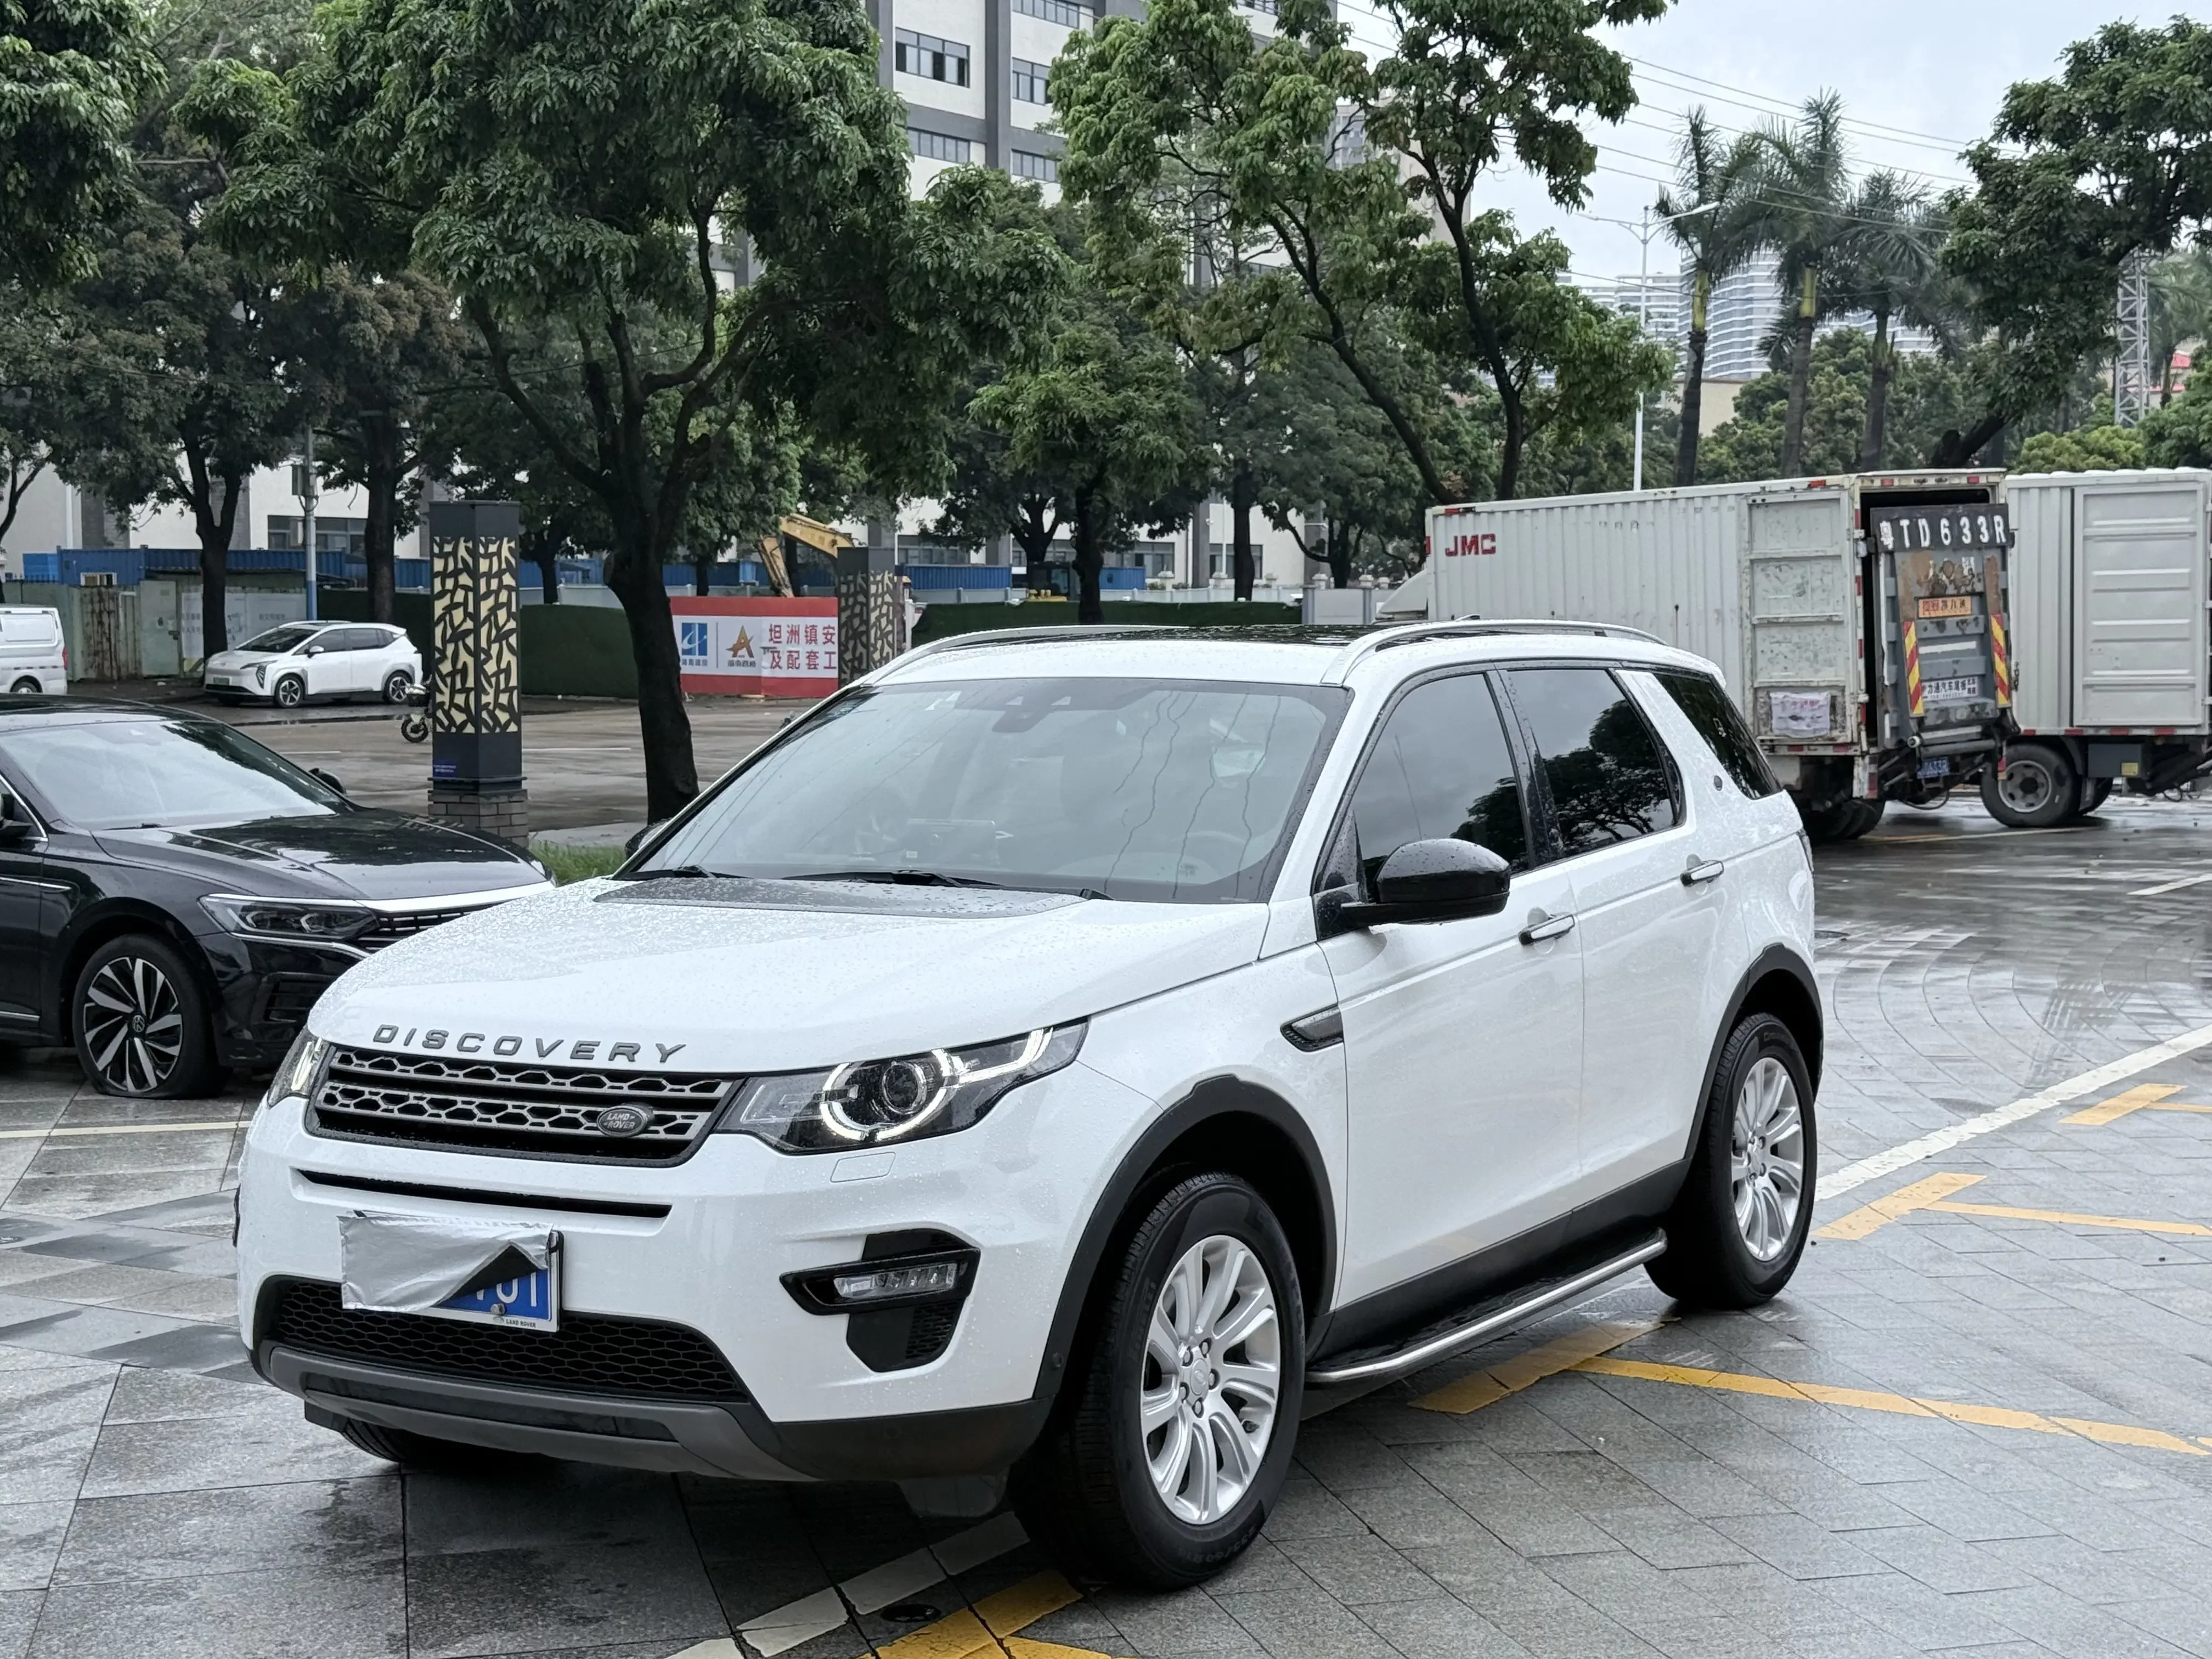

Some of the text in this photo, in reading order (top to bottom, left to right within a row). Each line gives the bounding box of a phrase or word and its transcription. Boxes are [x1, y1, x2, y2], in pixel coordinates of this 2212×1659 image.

[1880, 515, 2006, 550] 粤TD633R
[1445, 533, 1496, 557] JMC
[769, 623, 836, 645] 坦洲镇安
[770, 649, 837, 670] 及配套工
[373, 1024, 687, 1063] DISCOVERY
[607, 1121, 635, 1129] ROVER
